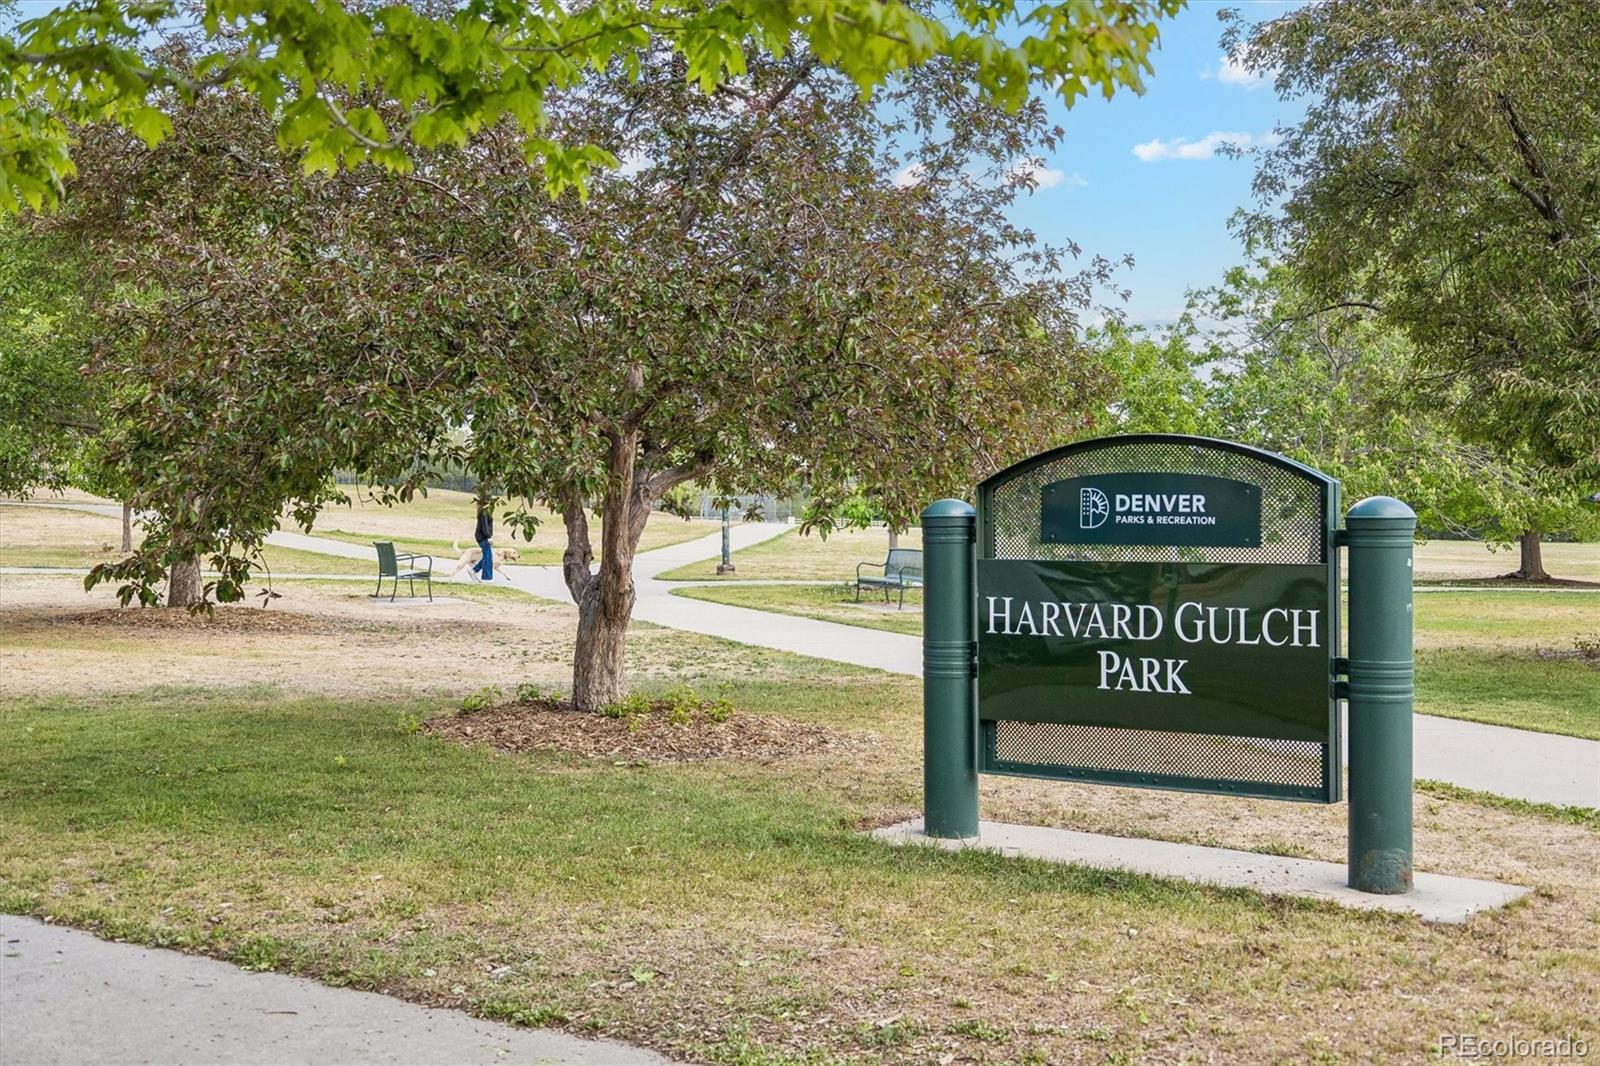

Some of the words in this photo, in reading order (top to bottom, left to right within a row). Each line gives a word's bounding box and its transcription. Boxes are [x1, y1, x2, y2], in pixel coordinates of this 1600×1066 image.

[1115, 494, 1206, 513] DENVER
[1115, 515, 1145, 525] PARKS
[1147, 516, 1154, 525] &
[1156, 516, 1216, 525] RECREATION
[985, 596, 1163, 641] HARVARD
[1174, 602, 1321, 648] GULCH
[1096, 650, 1192, 695] PARK
